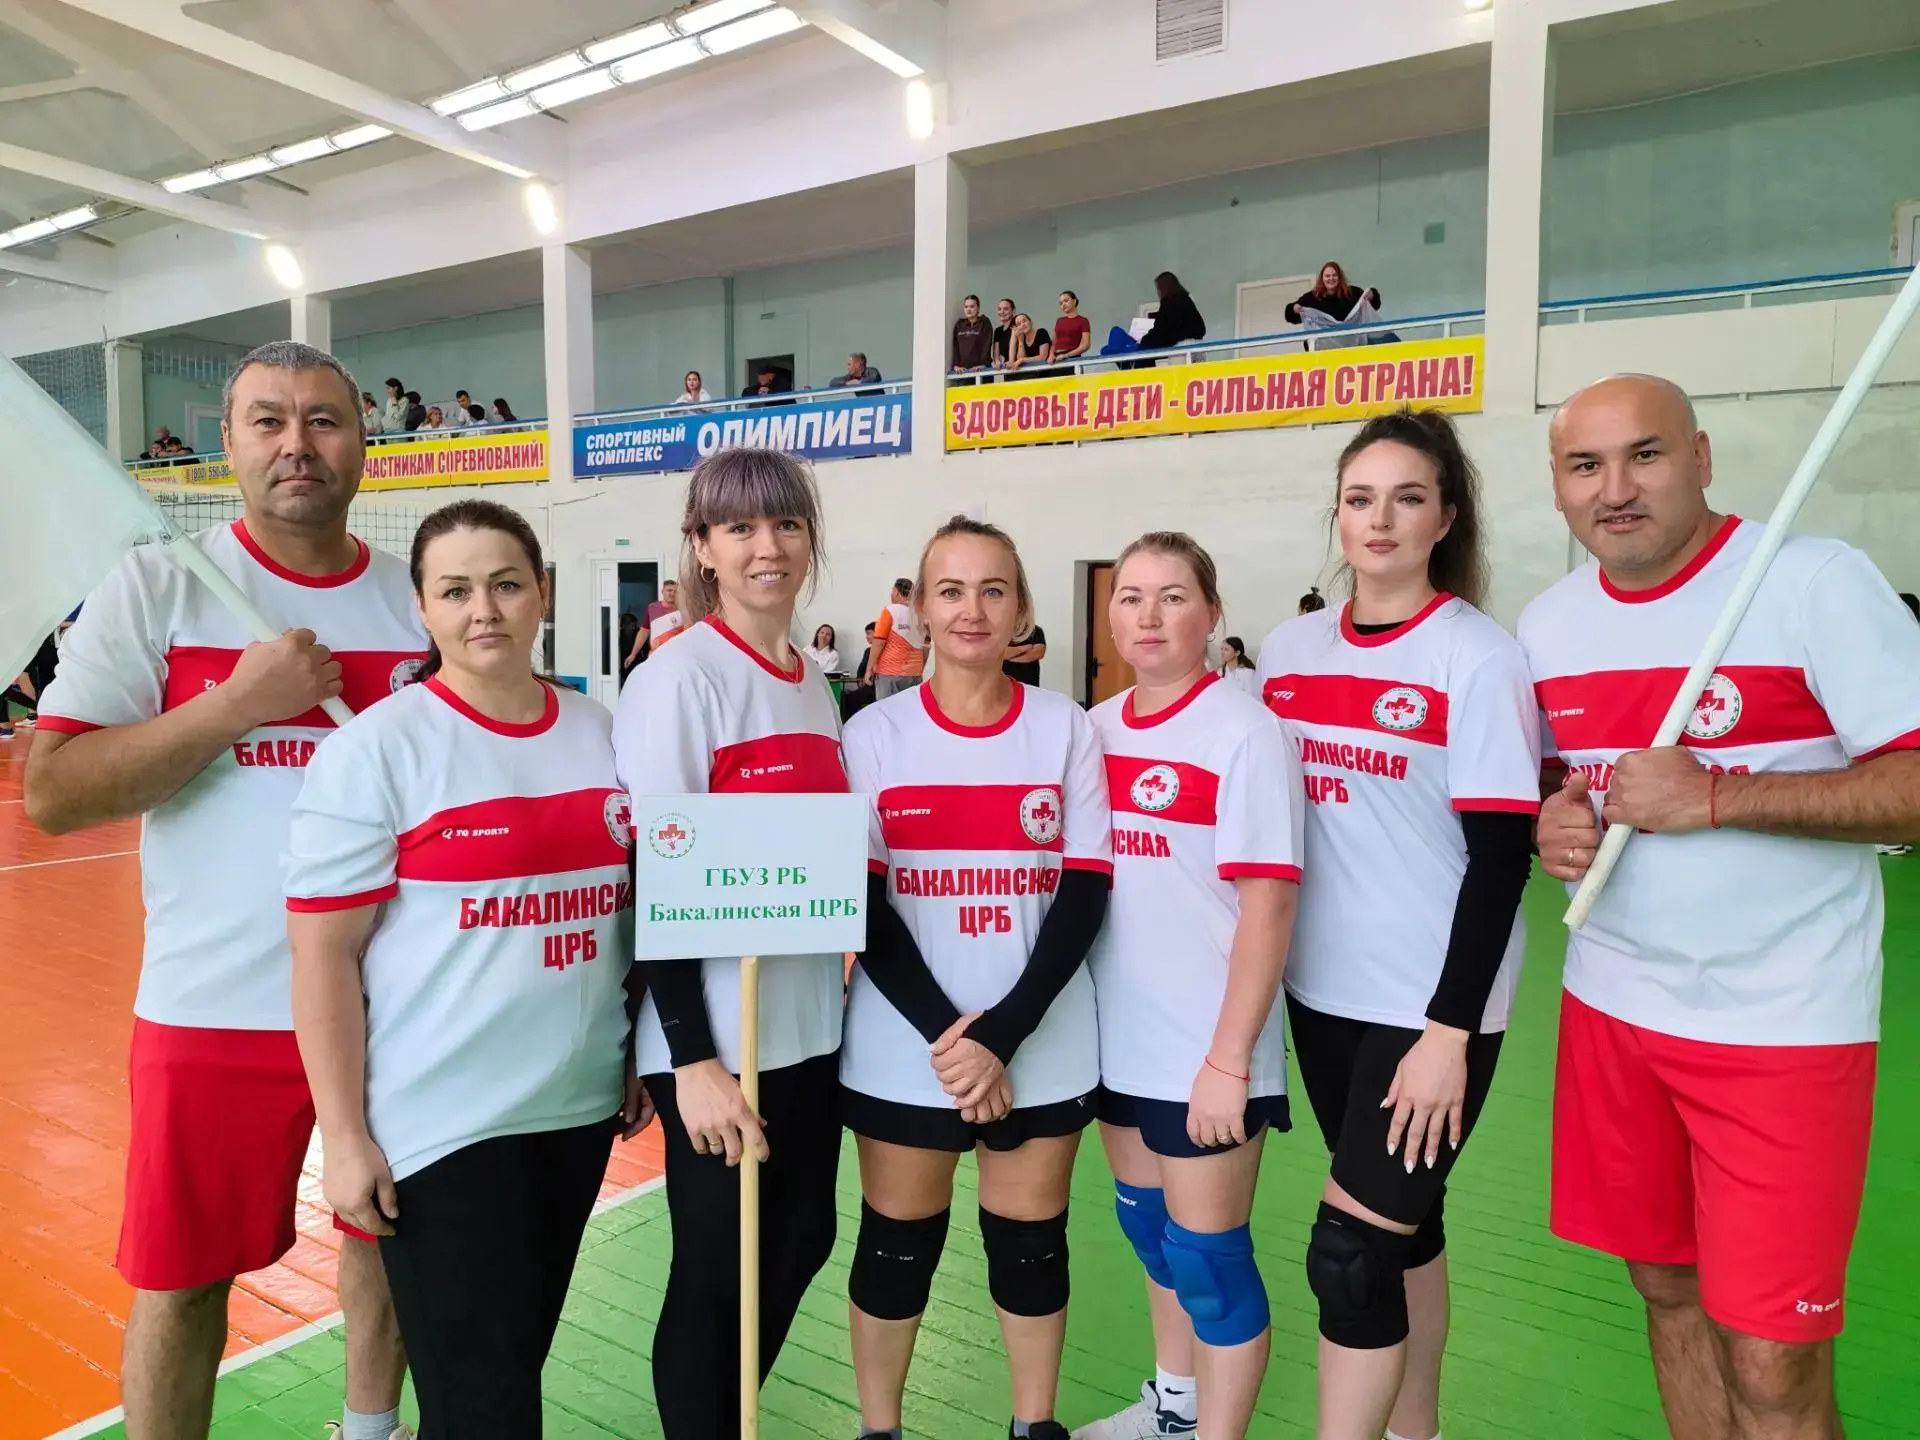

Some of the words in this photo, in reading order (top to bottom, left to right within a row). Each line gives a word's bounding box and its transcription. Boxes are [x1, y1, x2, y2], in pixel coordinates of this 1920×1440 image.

[953, 391, 1089, 438] ЗДОРОВЫЕ
[1094, 384, 1163, 429] ДЕТИ
[1187, 368, 1327, 417] СИЛЬНАЯ
[1335, 355, 1475, 405] СТРАНА!
[586, 423, 686, 450] СПОРТИВНЫЙ
[697, 405, 901, 456] ОЛИМПИЕЦ
[364, 452, 435, 479] ЧАСТНИКАМ
[438, 440, 544, 474] СОРЕВНОВАНИЙ!
[587, 446, 663, 467] КОМПЛЕКС
[767, 763, 794, 773] SPORTS
[1296, 737, 1408, 780] ЛИНСКАЯ
[1304, 775, 1349, 805] ЦРБ
[902, 808, 931, 816] SPORTS
[472, 827, 510, 837] SPORTS
[704, 868, 769, 887] ГБУЗ
[777, 867, 807, 885] РБ
[650, 903, 801, 922] Бакалинская
[809, 898, 858, 920] ЦРБ
[959, 906, 1012, 938] ЦРБ
[544, 929, 598, 971] ЦРБ
